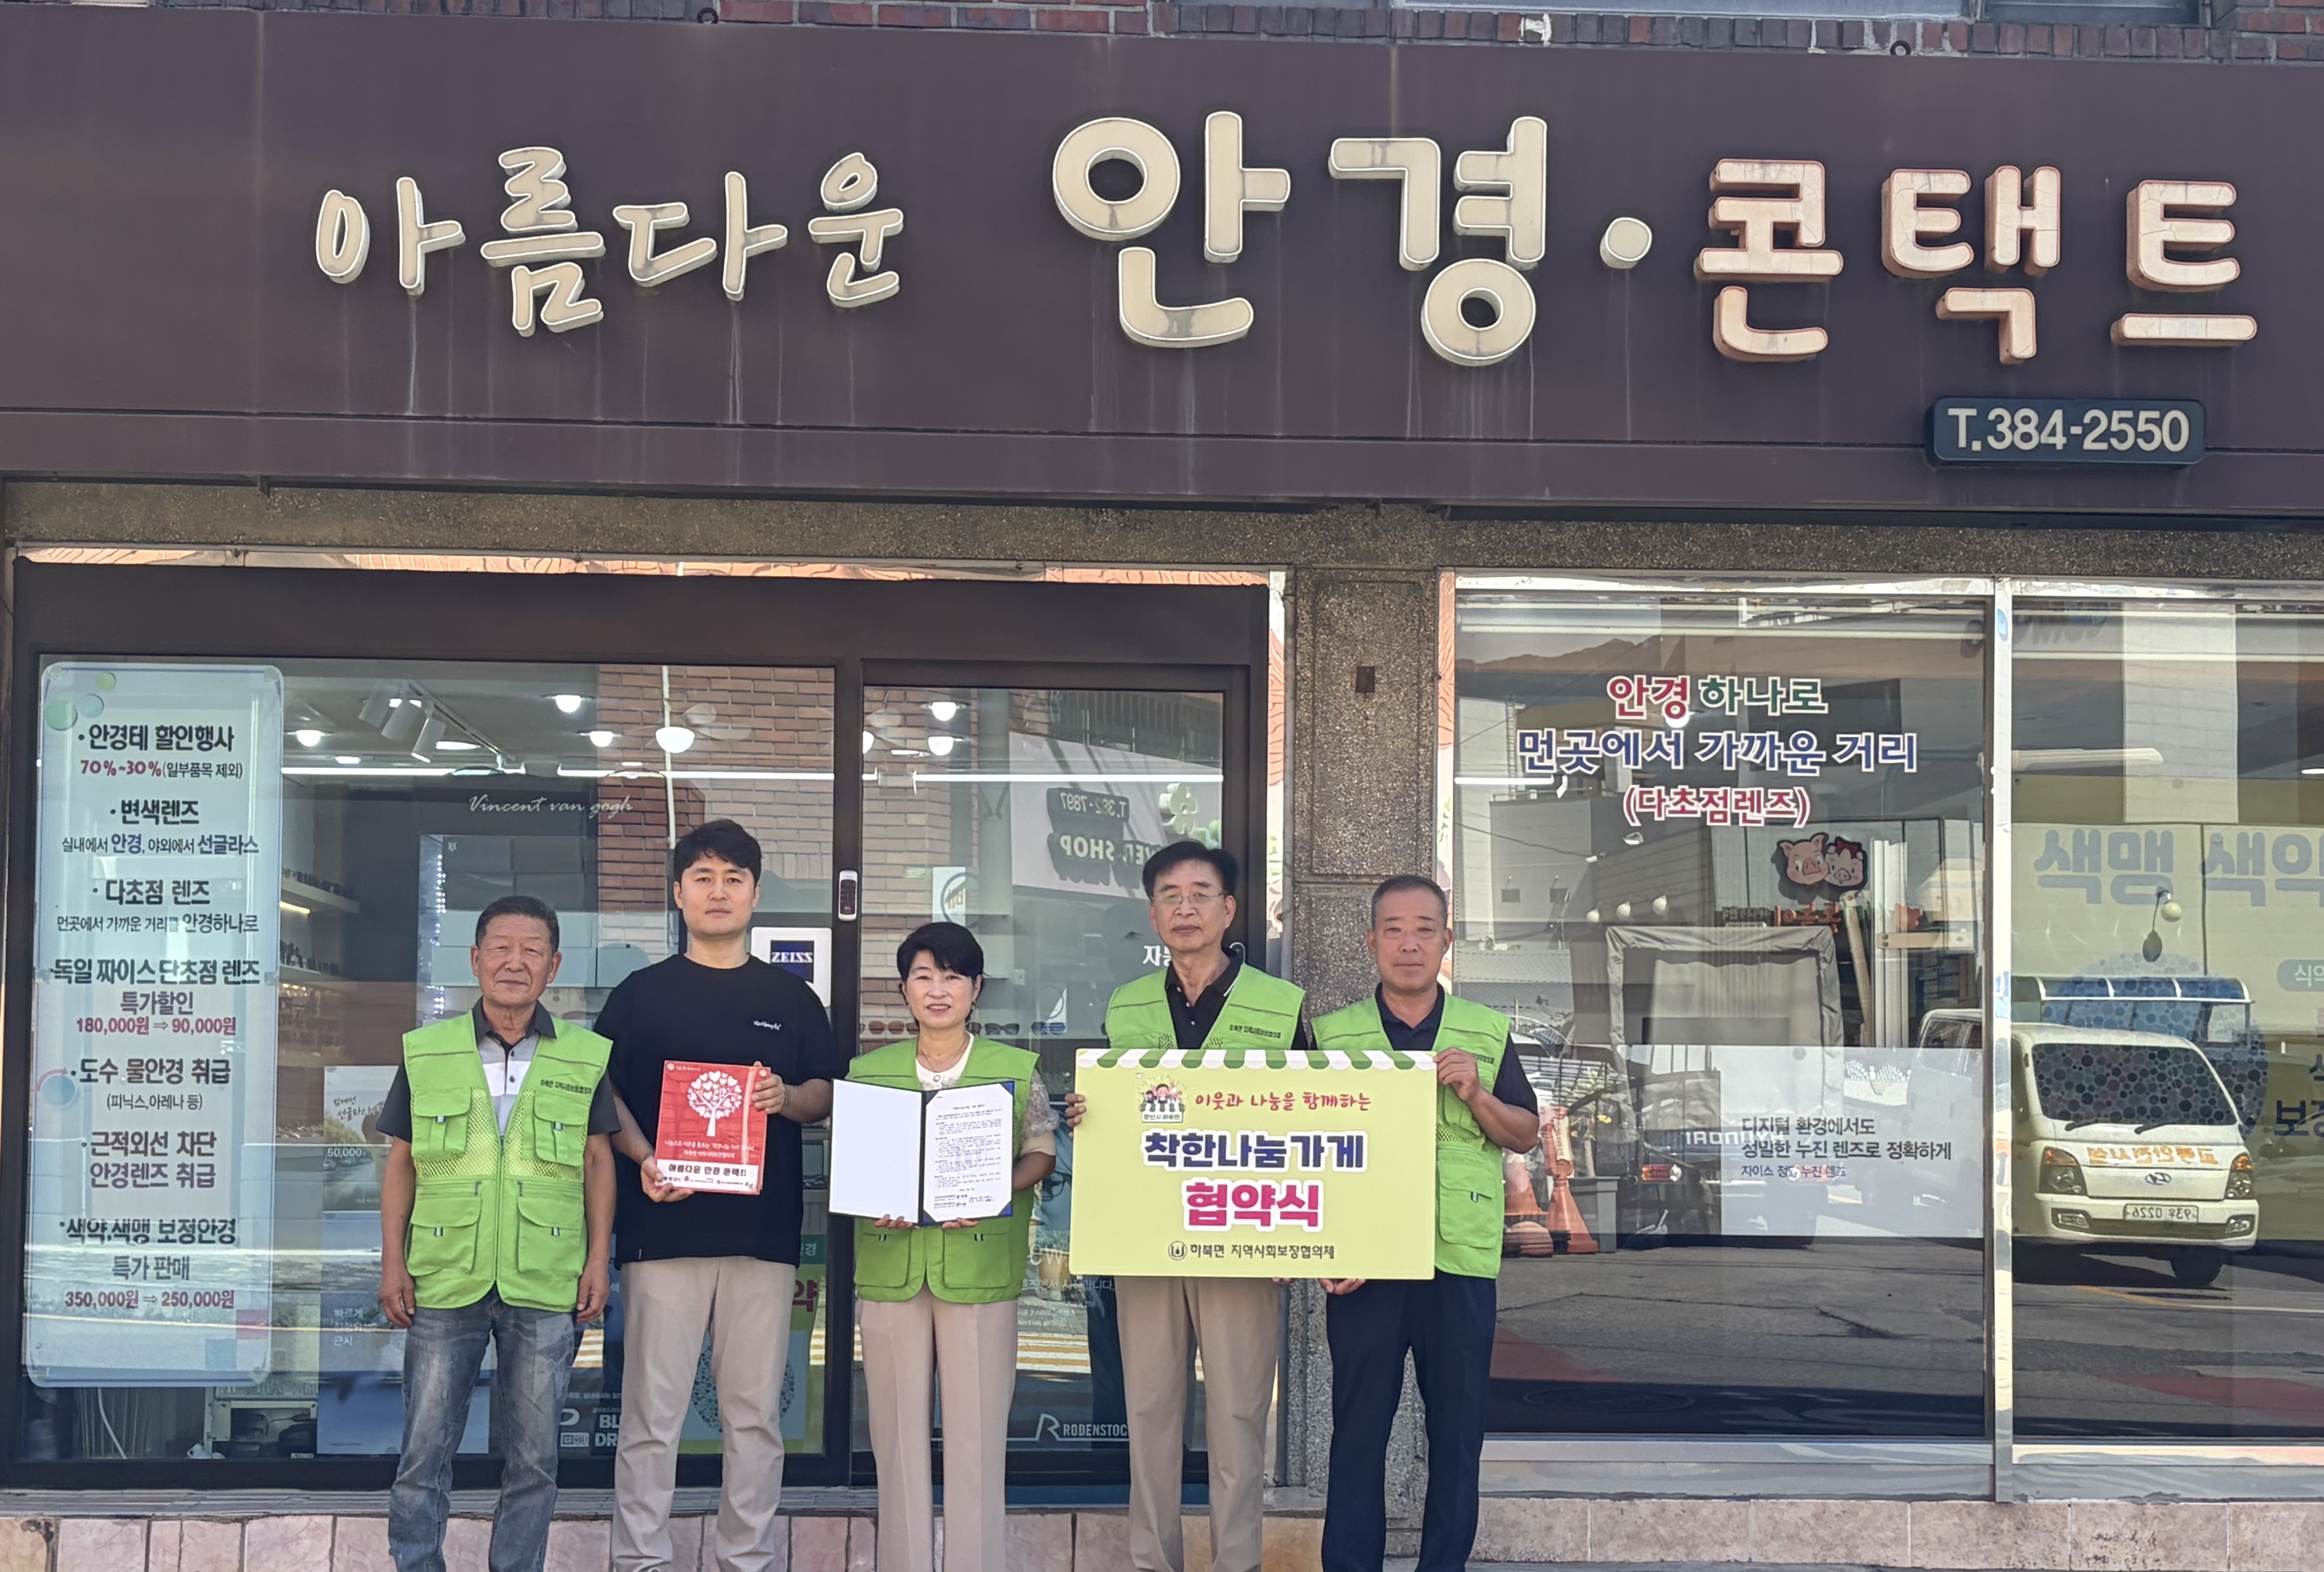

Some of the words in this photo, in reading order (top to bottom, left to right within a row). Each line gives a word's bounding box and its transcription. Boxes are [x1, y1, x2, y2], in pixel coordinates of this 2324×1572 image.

[316, 146, 903, 337] 아름다운
[1053, 111, 1546, 366] 안경
[1694, 159, 2257, 363] 콘택트
[1947, 408, 2189, 452] T.384-2550
[1607, 675, 1690, 720] 안경
[1698, 675, 1828, 716] 하나로
[89, 725, 148, 750] 안경테
[155, 726, 234, 751] 할인행사
[1517, 728, 1684, 774] 먼곳에서
[1695, 731, 1826, 777] 가까운
[1832, 731, 1917, 773] 거리
[121, 799, 199, 825] 변색렌즈
[469, 794, 546, 812] Vincent
[550, 800, 585, 812] van
[590, 795, 634, 819] gogh
[1623, 785, 1810, 828] (다초점렌즈)
[62, 836, 108, 853] 실내에서
[148, 838, 195, 855] 야외에서
[197, 835, 259, 855] 선글라스
[2034, 829, 2173, 905] 색맹
[106, 879, 163, 905] 다초점
[172, 880, 211, 904] 렌즈
[57, 916, 103, 932] 먼곳에서
[106, 916, 141, 932] 가까운
[144, 916, 179, 933] 거리를
[183, 913, 259, 933] 안경하나로
[772, 952, 813, 963] ZEISS
[54, 959, 93, 984] 독일
[159, 959, 217, 985] 단초점
[222, 959, 260, 985] 렌즈
[120, 991, 193, 1015] 특가할인
[76, 1017, 149, 1035] 180,000원
[172, 1017, 236, 1036] 90,000원
[80, 1058, 119, 1084] 도수
[125, 1058, 184, 1084] 물안경
[191, 1058, 231, 1085] 취급
[187, 1094, 203, 1110] 등)
[1196, 1091, 1243, 1110] 이웃과
[1302, 1091, 1371, 1112] 함께하는
[1742, 1117, 1790, 1135] 디지털
[1796, 1117, 1876, 1136] 환경에서도
[91, 1131, 168, 1157] 근적외선
[176, 1131, 216, 1157] 차단
[327, 1148, 362, 1158] 50,000
[1145, 1133, 1365, 1169] 착한나눔가게
[1796, 1141, 1829, 1159] 누진
[1833, 1142, 1881, 1159] 렌즈로
[1886, 1141, 1951, 1160] 정확하게
[90, 1163, 168, 1189] 안경렌즈
[176, 1162, 216, 1189] 취급
[1742, 1165, 1774, 1177] 자이스
[1186, 1183, 1321, 1228] 협약식
[158, 1218, 236, 1245] 보정안경
[1190, 1244, 1224, 1259] 하북면
[1231, 1244, 1335, 1260] 지역사회보장협의체
[112, 1255, 149, 1280] 특가
[153, 1255, 190, 1280] 판매
[65, 1290, 139, 1309] 350,000원
[161, 1290, 235, 1309] 250,000원
